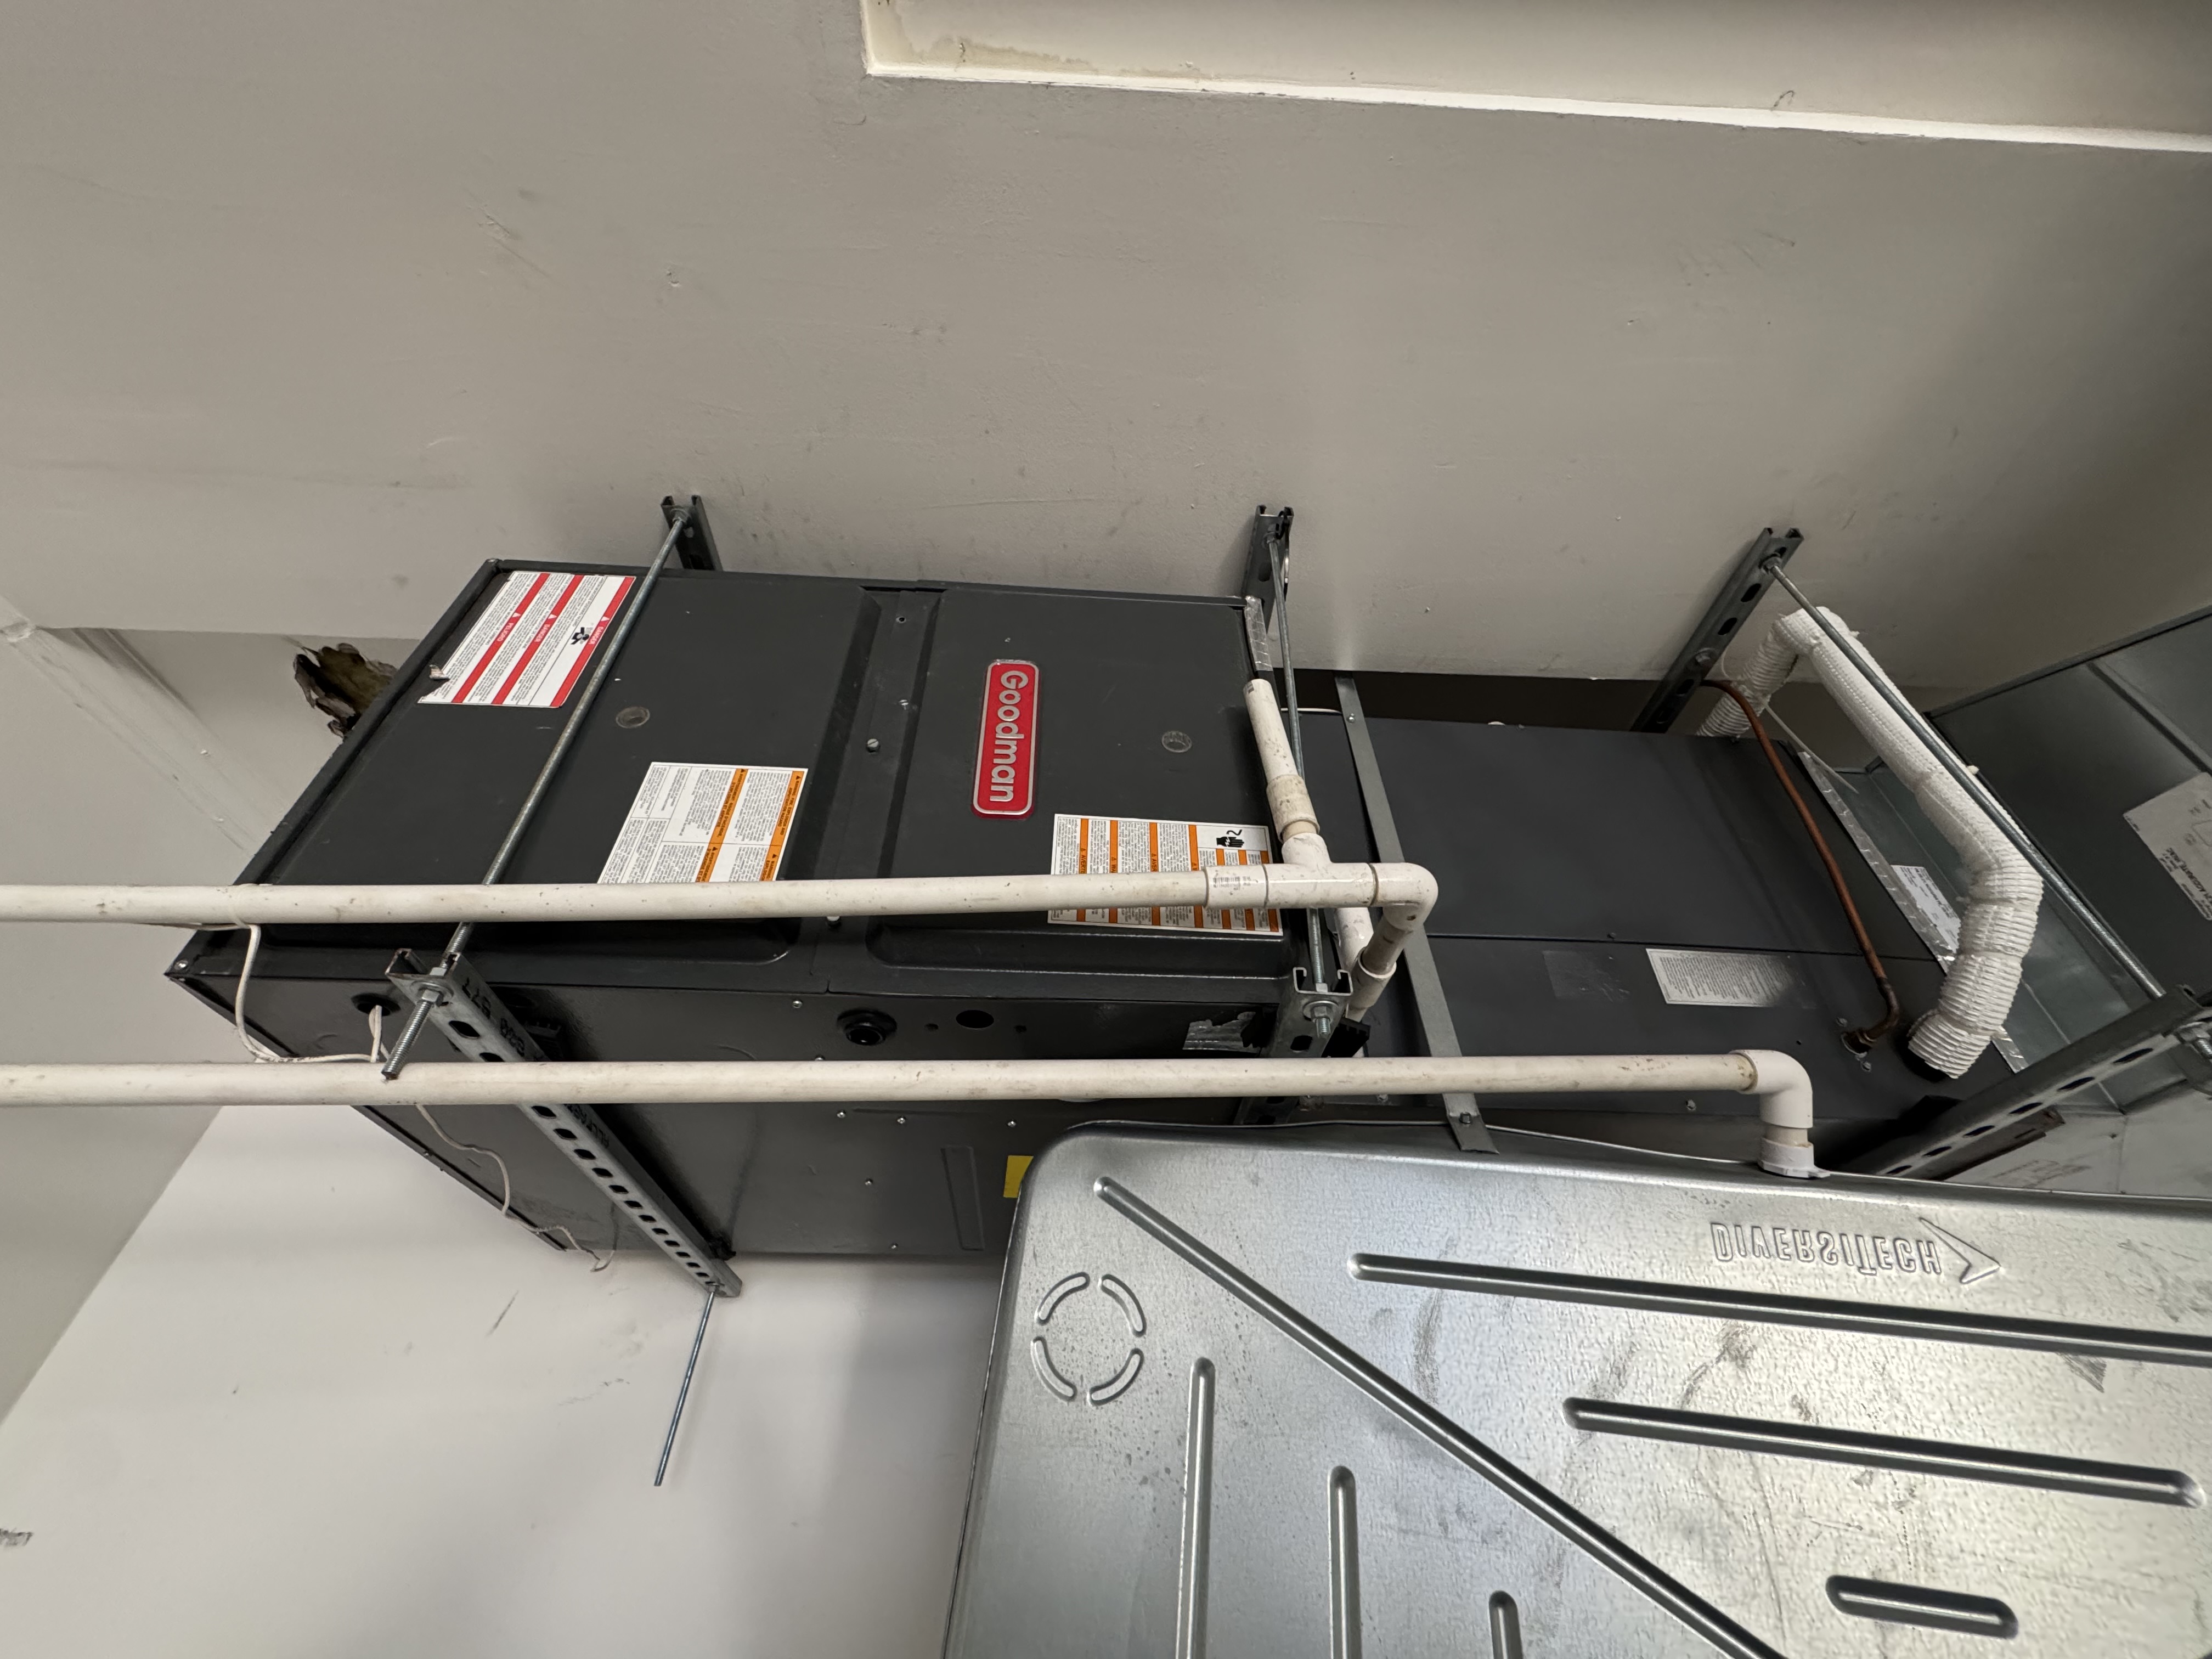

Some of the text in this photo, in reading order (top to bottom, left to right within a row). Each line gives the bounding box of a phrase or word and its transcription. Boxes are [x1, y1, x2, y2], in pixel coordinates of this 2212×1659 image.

[495, 622, 515, 641] PELIGRO
[533, 624, 551, 642] DANGER
[588, 627, 604, 644] DANGER
[990, 670, 1028, 802] Goodman
